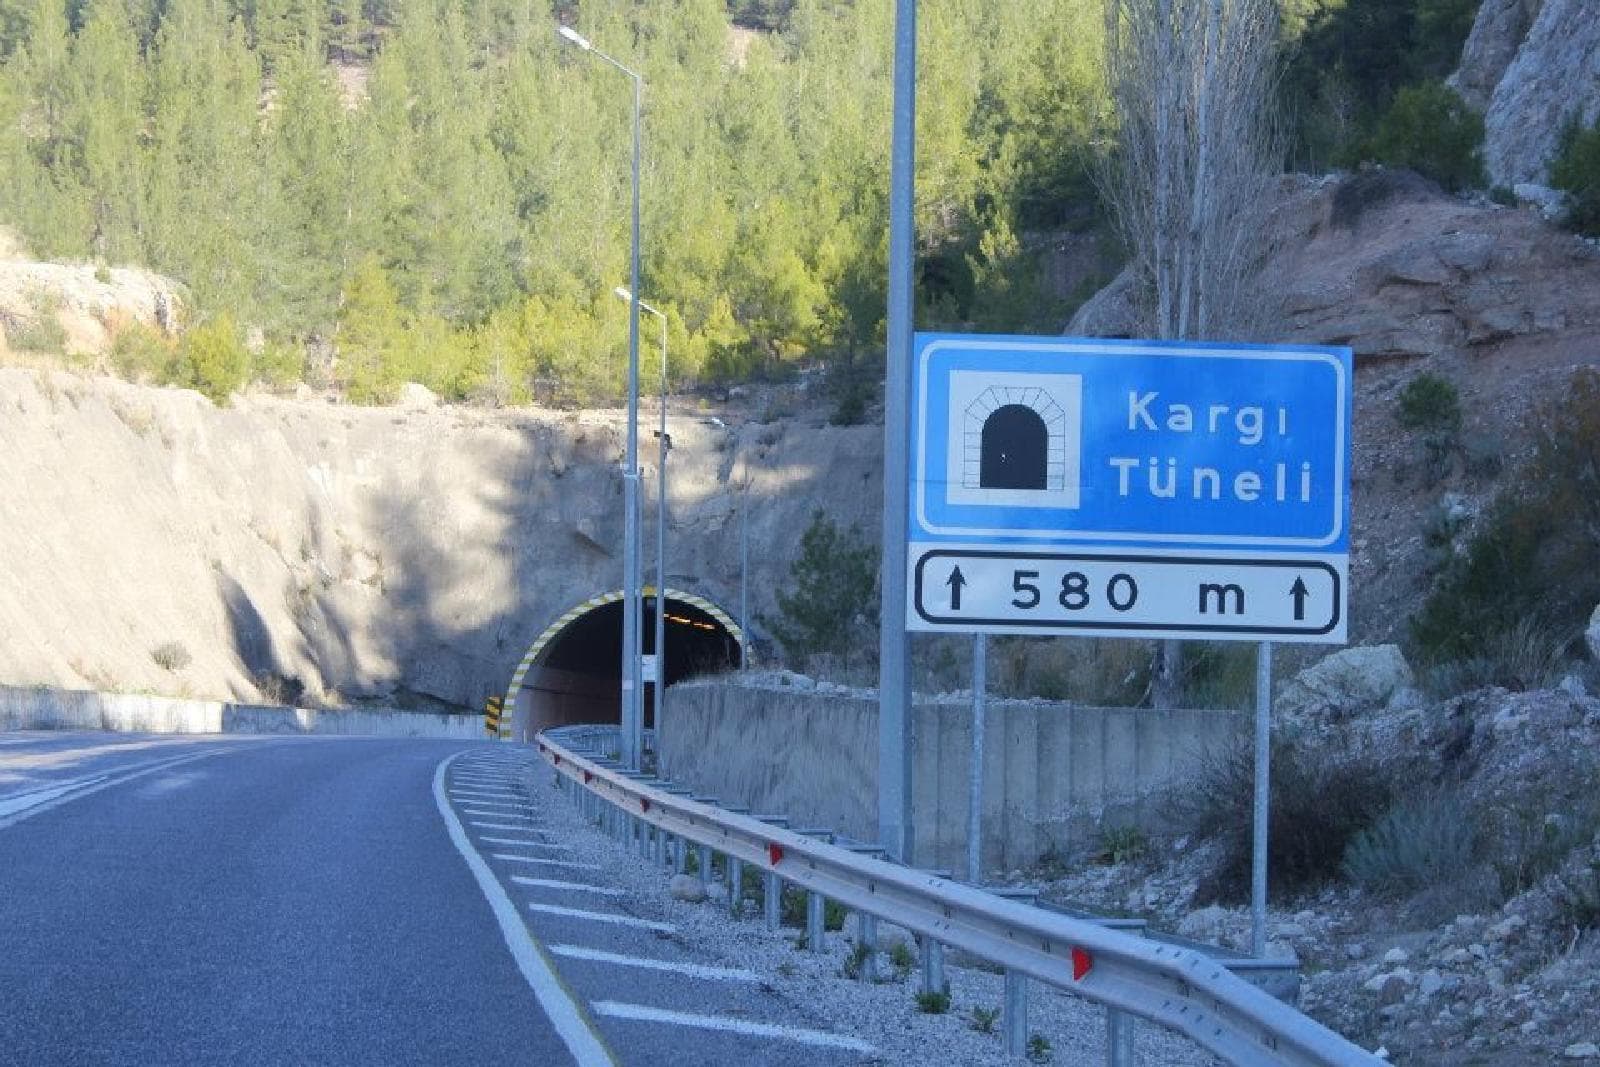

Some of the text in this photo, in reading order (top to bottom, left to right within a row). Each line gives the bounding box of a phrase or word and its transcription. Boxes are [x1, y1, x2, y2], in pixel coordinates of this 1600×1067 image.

[1128, 390, 1286, 446] Kargı
[1109, 456, 1310, 503] Tüneli
[1011, 569, 1245, 615] 580 m
